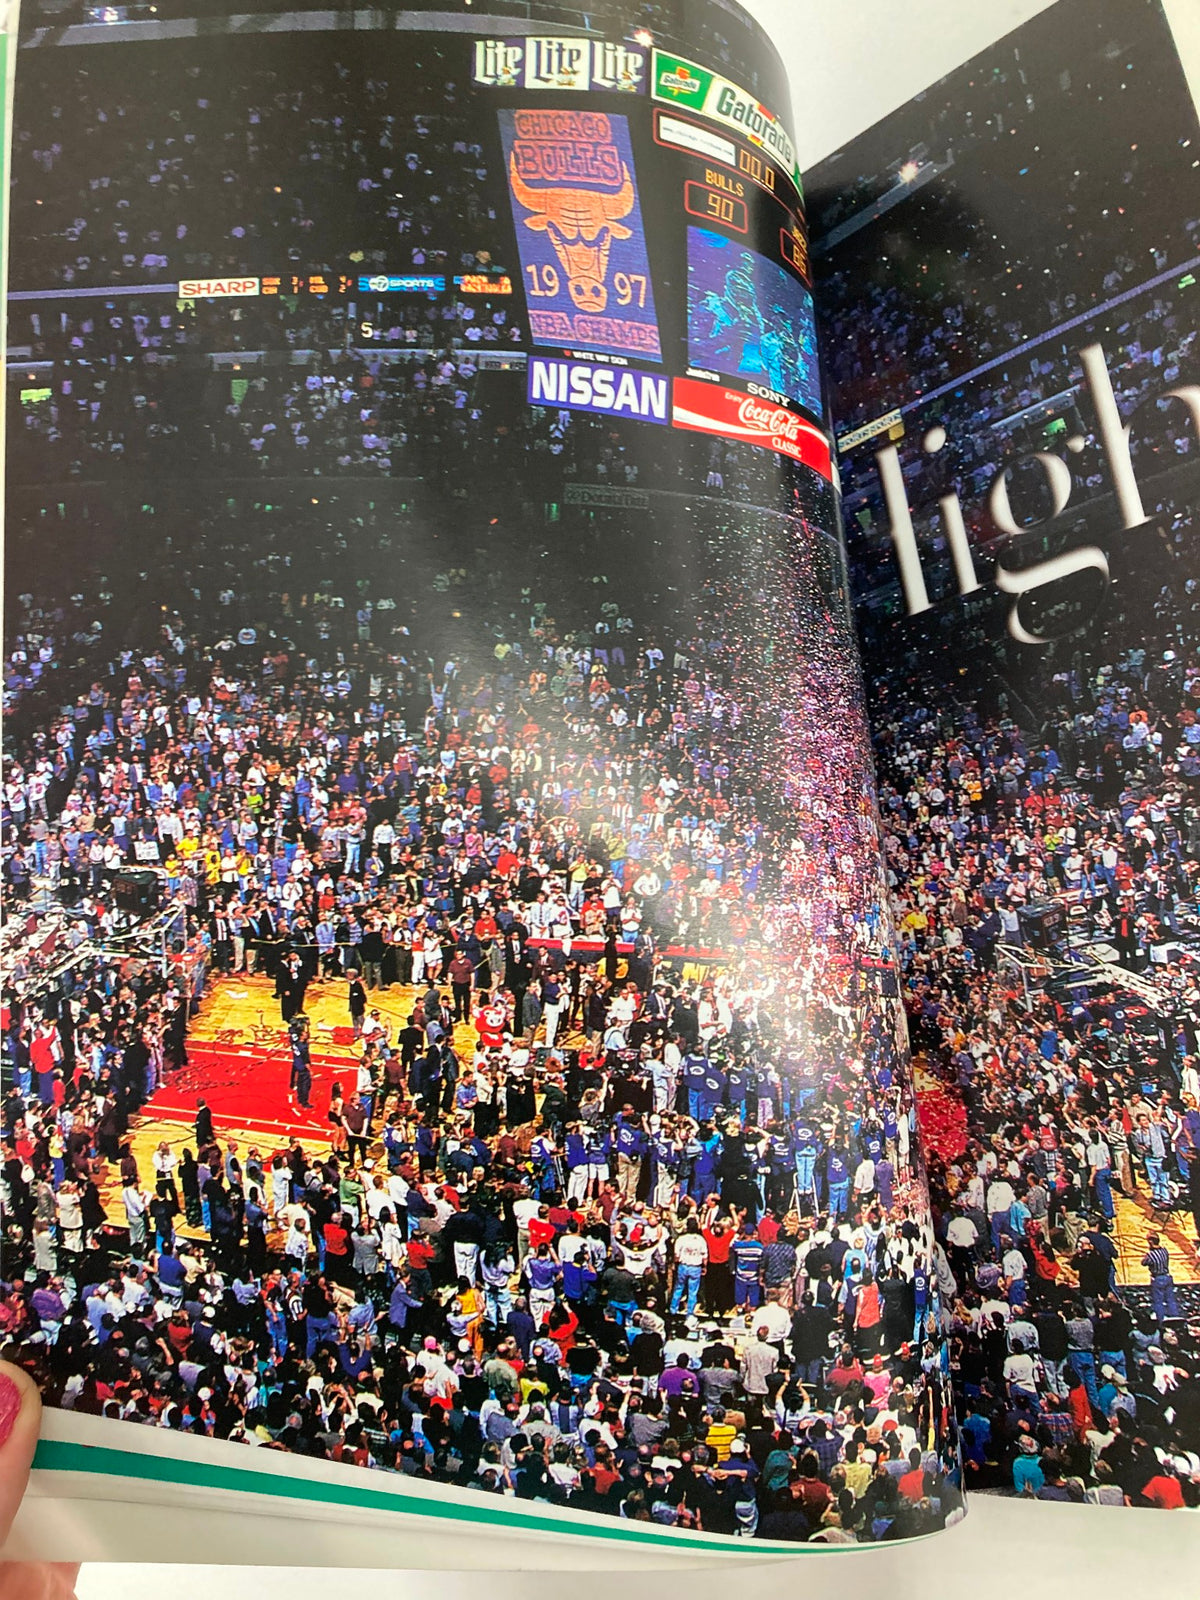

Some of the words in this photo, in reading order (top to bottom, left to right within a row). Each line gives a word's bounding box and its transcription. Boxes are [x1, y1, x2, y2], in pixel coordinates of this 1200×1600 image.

[475, 40, 523, 85] Lite
[533, 39, 581, 84] Lite
[592, 41, 643, 88] Lite
[516, 112, 610, 140] CHICAGO
[716, 87, 793, 163] Gatorade
[515, 144, 620, 182] BULLS
[705, 168, 744, 197] BULLS
[707, 193, 734, 222] 90
[182, 281, 256, 295] SHARP
[390, 279, 434, 288] SPORTS
[526, 264, 560, 297] 19
[614, 272, 647, 308] 97
[360, 322, 373, 338] 5
[530, 312, 573, 338] NBA
[574, 317, 661, 352] CHAMPS
[532, 361, 667, 419] NISSAN
[747, 382, 791, 407] SONY
[738, 398, 800, 441] Coca-Cola
[771, 437, 802, 458] CLASSIC
